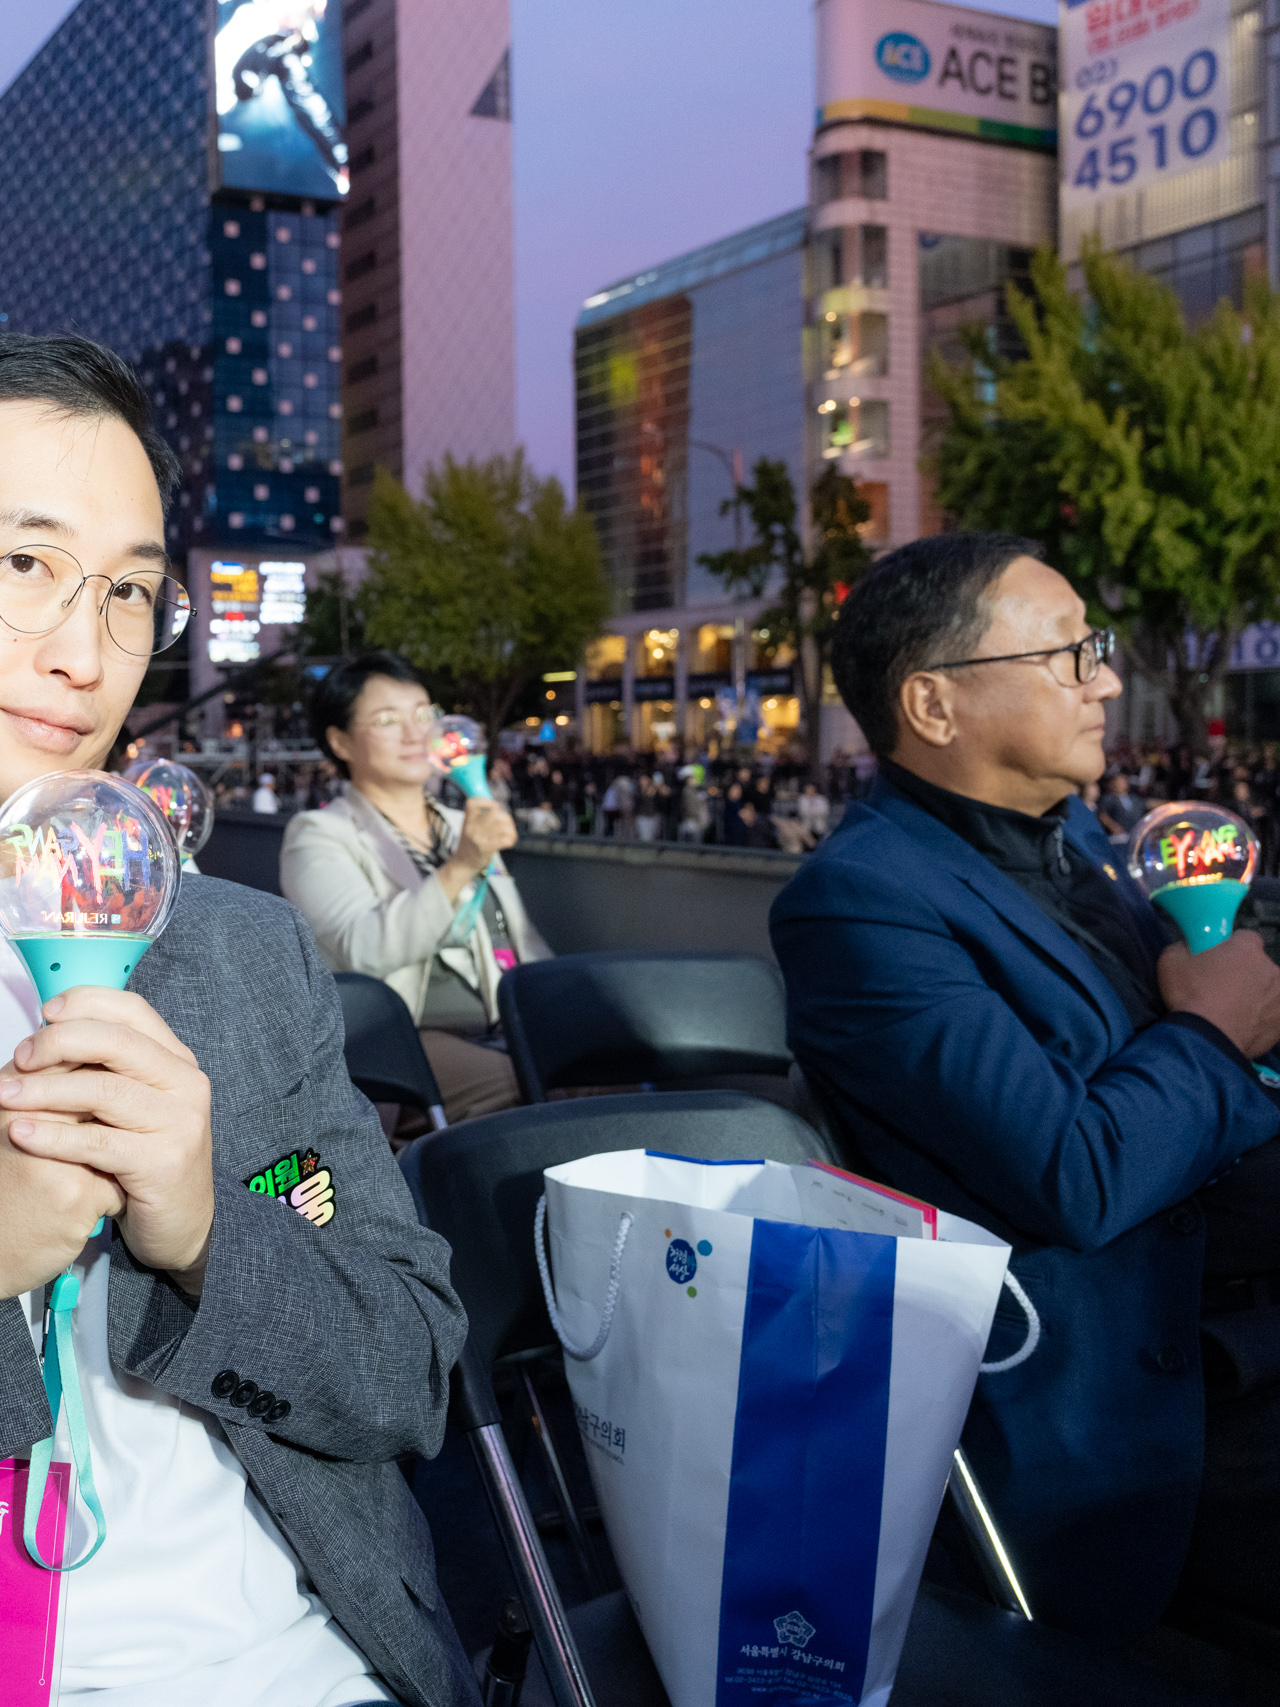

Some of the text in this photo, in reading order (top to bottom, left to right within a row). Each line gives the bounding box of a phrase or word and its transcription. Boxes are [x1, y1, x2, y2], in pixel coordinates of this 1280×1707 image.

[937, 46, 1018, 101] ACE
[1074, 48, 1218, 141] 6900
[1073, 107, 1218, 191] 4510
[574, 1402, 626, 1455] 남구의회
[740, 1644, 845, 1673] 서울특별시 강남구의회
